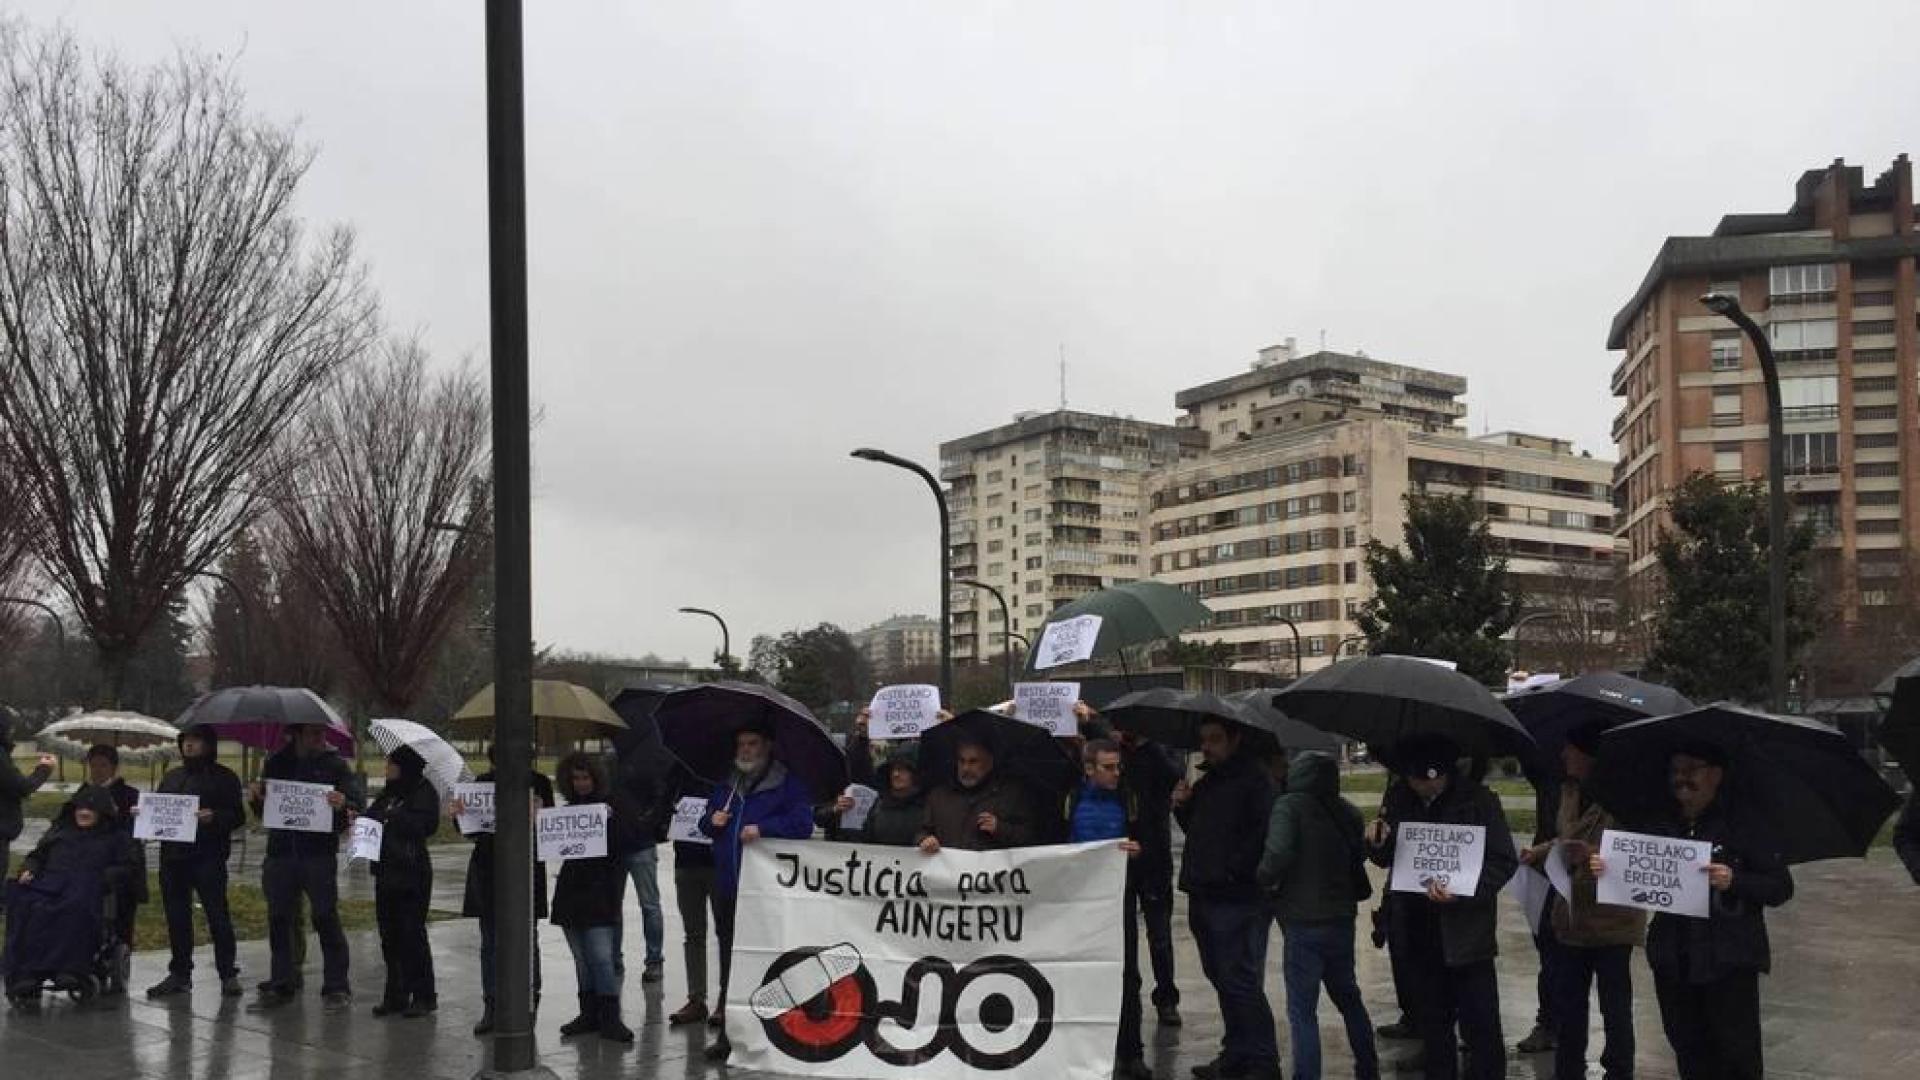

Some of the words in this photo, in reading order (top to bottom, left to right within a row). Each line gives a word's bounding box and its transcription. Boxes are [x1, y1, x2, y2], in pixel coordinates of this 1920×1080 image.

[540, 813, 604, 833] JUSTICIA
[1405, 827, 1474, 845] BESTELAKO
[1418, 842, 1459, 858] POLIZI
[1613, 837, 1697, 861] BESTELAKO
[1413, 856, 1461, 873] EREDUA
[1628, 854, 1678, 874] POLIZI
[775, 850, 928, 899] Justicia
[956, 865, 1031, 901] para
[1624, 869, 1682, 890] EREDUA
[875, 900, 1024, 943] AINGERU
